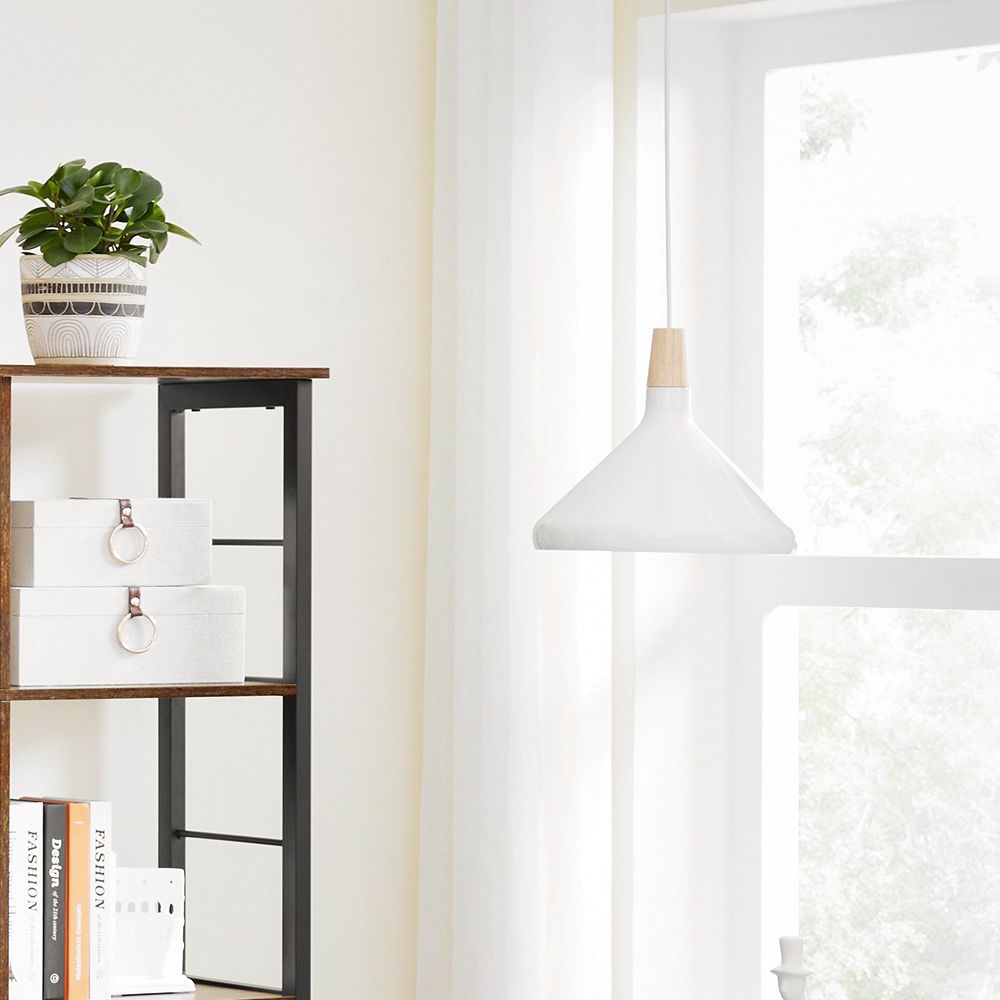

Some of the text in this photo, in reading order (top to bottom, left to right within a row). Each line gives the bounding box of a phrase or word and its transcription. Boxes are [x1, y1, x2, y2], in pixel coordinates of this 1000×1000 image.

[27, 830, 38, 912] FASHION
[48, 837, 62, 888] Design
[95, 829, 105, 910] FASHION
